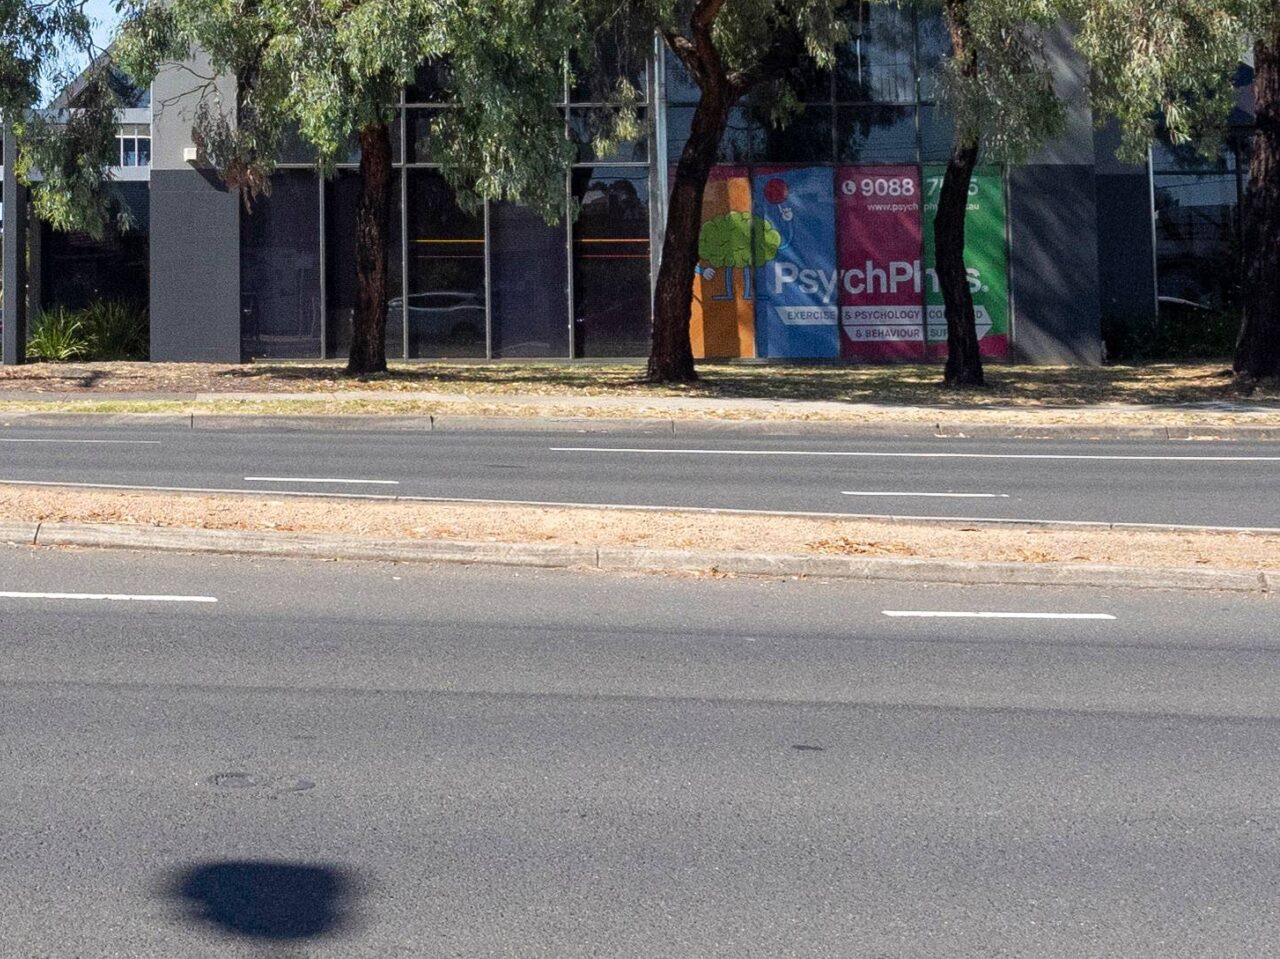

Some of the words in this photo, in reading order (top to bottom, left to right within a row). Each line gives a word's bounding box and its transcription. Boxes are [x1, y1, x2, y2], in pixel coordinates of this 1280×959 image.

[860, 177, 915, 197] 9088
[926, 177, 979, 196] 75
[774, 260, 990, 304] PsychPhs.
[787, 311, 836, 321] EXERCISE
[854, 311, 920, 320] PSYCHOLOGY
[855, 328, 862, 338] &
[865, 328, 921, 338] BEHAVIOUR
